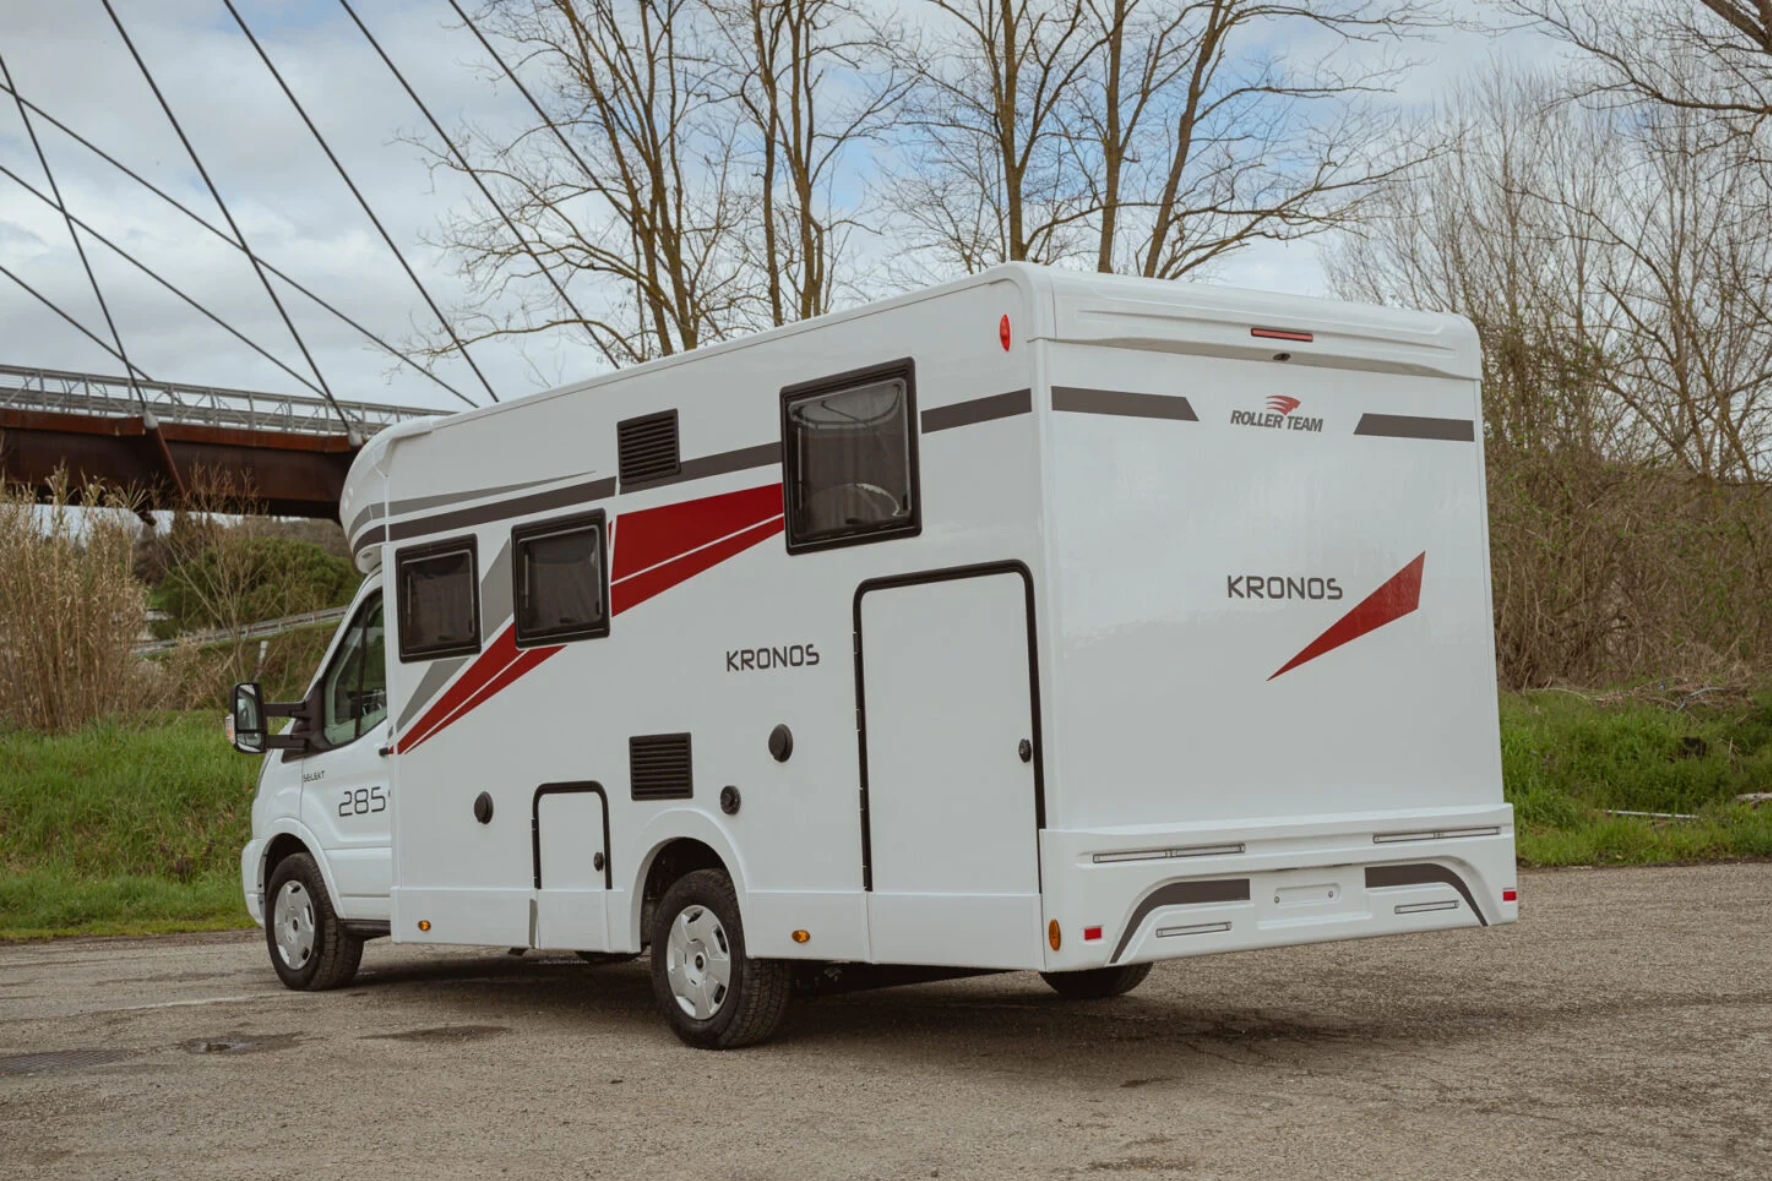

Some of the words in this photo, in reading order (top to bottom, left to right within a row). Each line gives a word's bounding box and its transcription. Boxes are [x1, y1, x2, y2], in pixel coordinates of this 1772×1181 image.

[1230, 409, 1285, 429] ROLLER
[1286, 415, 1324, 433] TEAM
[1227, 575, 1343, 600] KRONOS
[726, 643, 820, 672] KRONOS
[338, 786, 391, 817] 285
